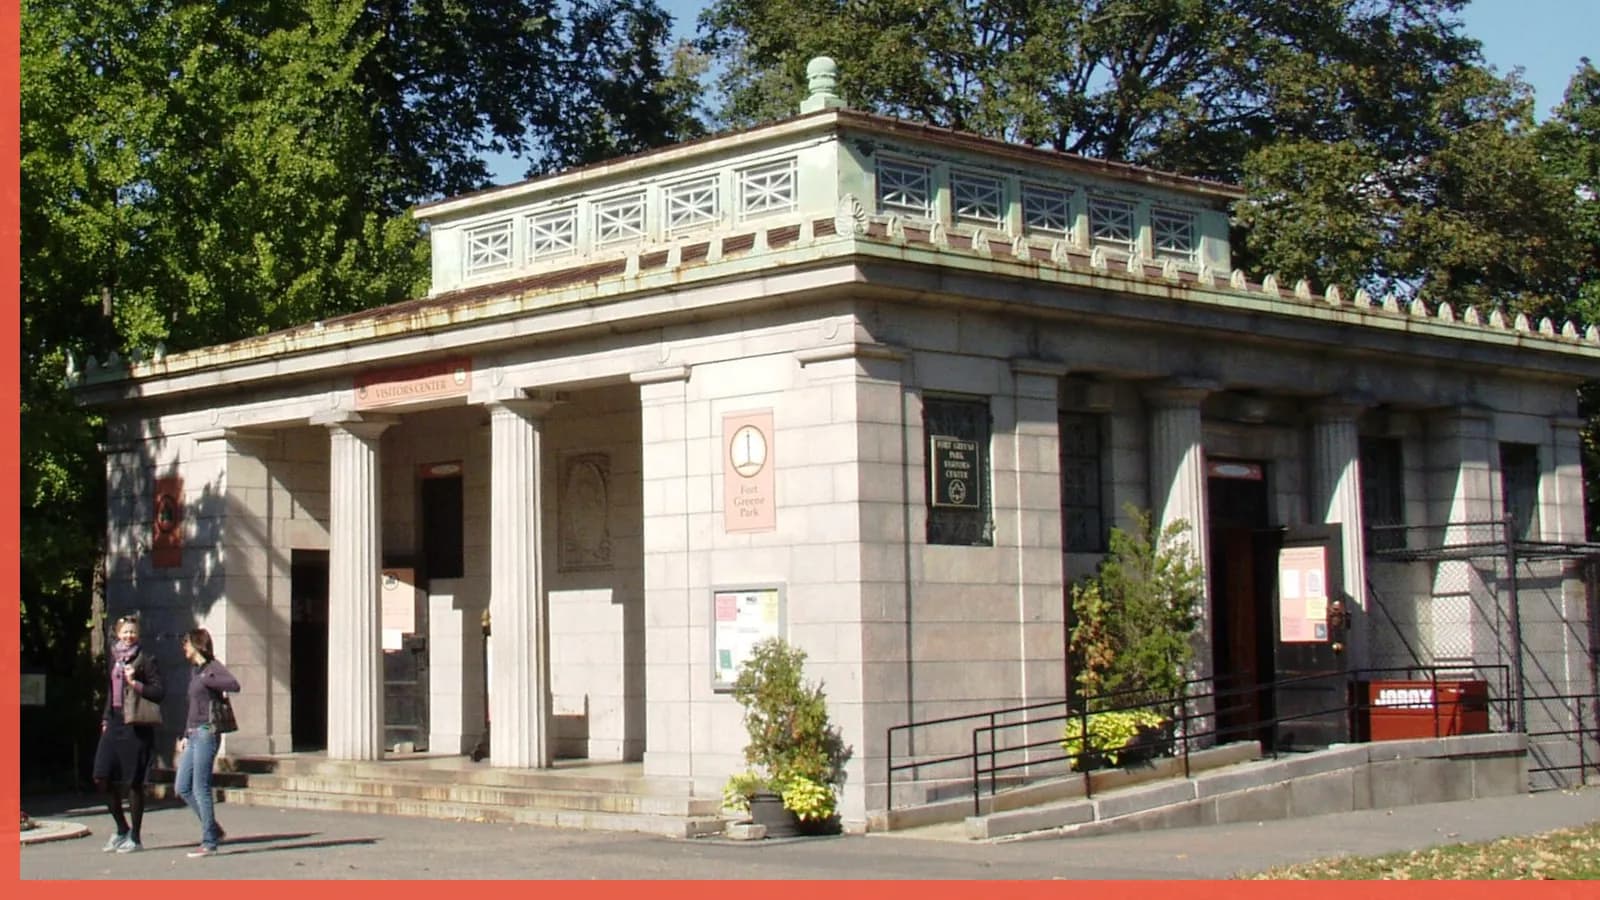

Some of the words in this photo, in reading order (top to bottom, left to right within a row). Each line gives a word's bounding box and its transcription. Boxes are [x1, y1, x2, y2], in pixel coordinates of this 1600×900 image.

[375, 384, 413, 399] VISITORS
[414, 380, 447, 394] CENTER
[948, 450, 965, 460] PARK
[945, 470, 969, 479] CENTER
[740, 484, 759, 495] Fort
[733, 496, 766, 507] Greene
[740, 507, 760, 518] Park
[1374, 688, 1434, 709] JOBOX
